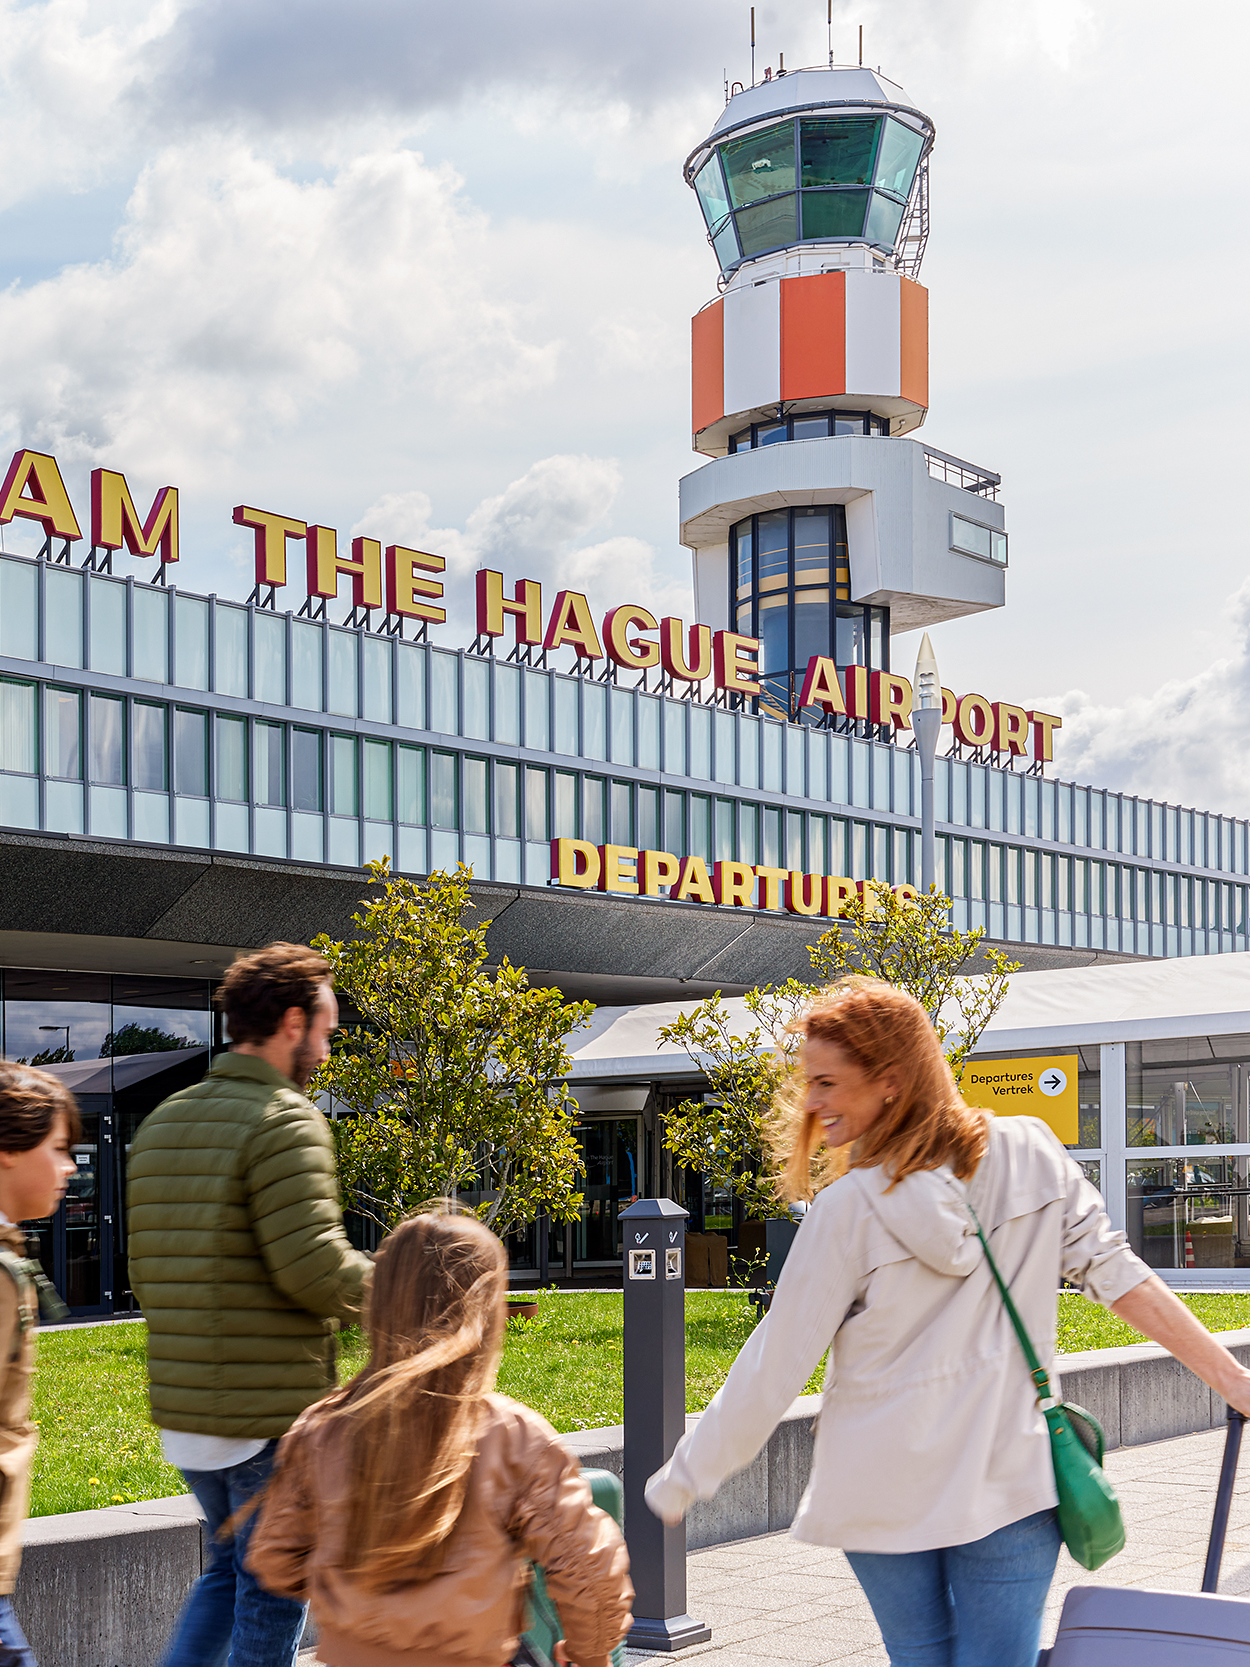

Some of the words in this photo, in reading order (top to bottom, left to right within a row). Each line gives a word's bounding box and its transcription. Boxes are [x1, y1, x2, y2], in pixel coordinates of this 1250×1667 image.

[231, 505, 447, 624] THE
[475, 568, 762, 696] HAGUE
[971, 1072, 1034, 1086] Departures
[992, 1084, 1034, 1096] Vertrek
